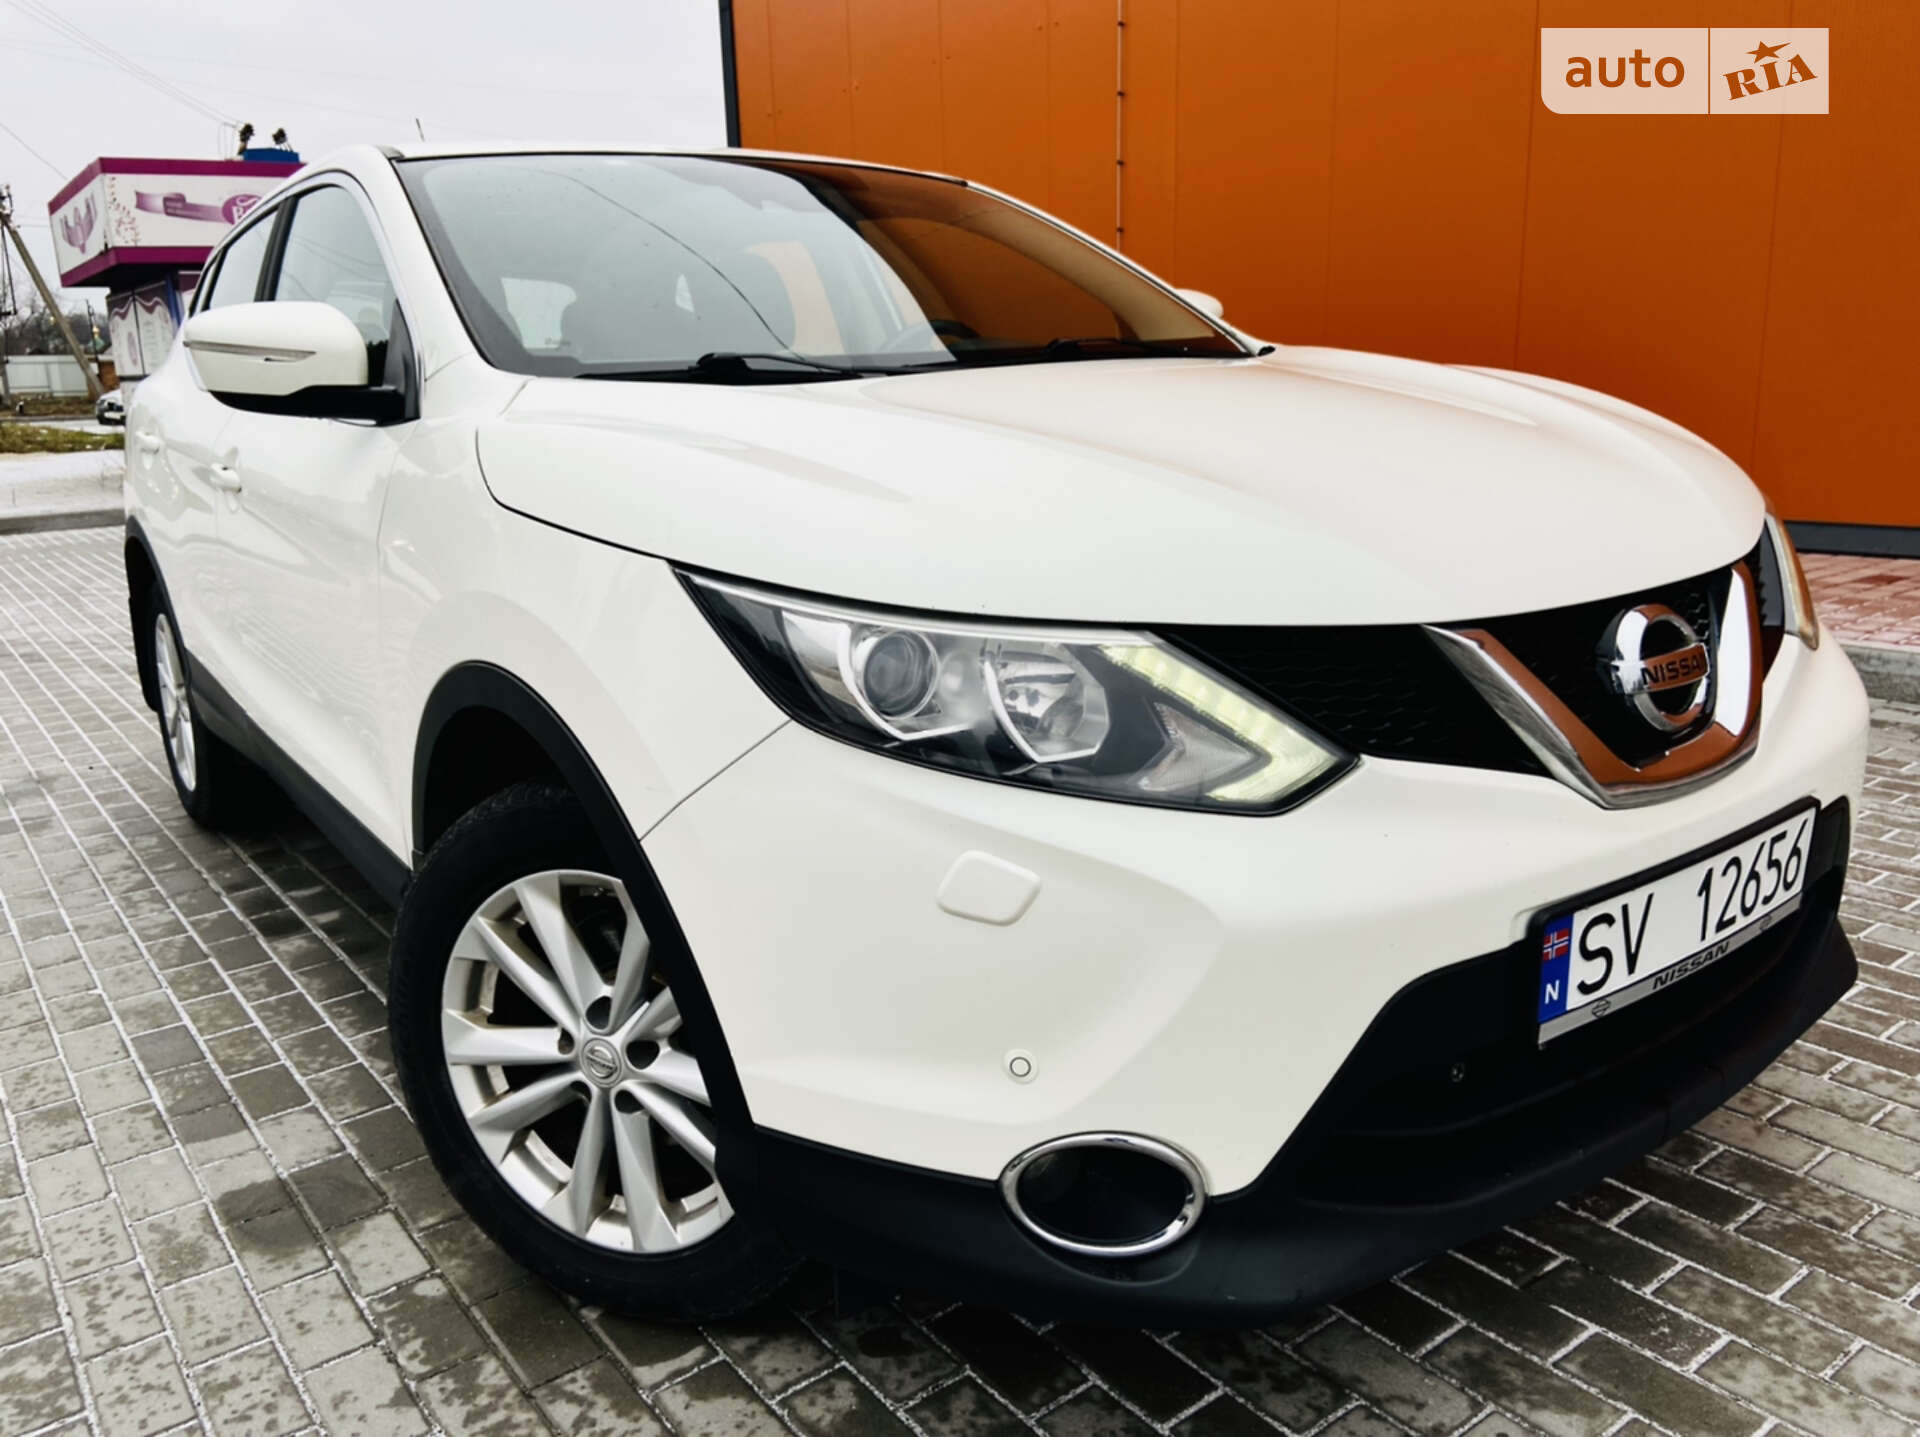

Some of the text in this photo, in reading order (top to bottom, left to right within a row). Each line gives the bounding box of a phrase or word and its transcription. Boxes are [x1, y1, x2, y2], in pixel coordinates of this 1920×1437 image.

[1576, 817, 1809, 996] SV 12656
[1652, 941, 1731, 991] NISSAN
[1544, 979, 1560, 1005] N
